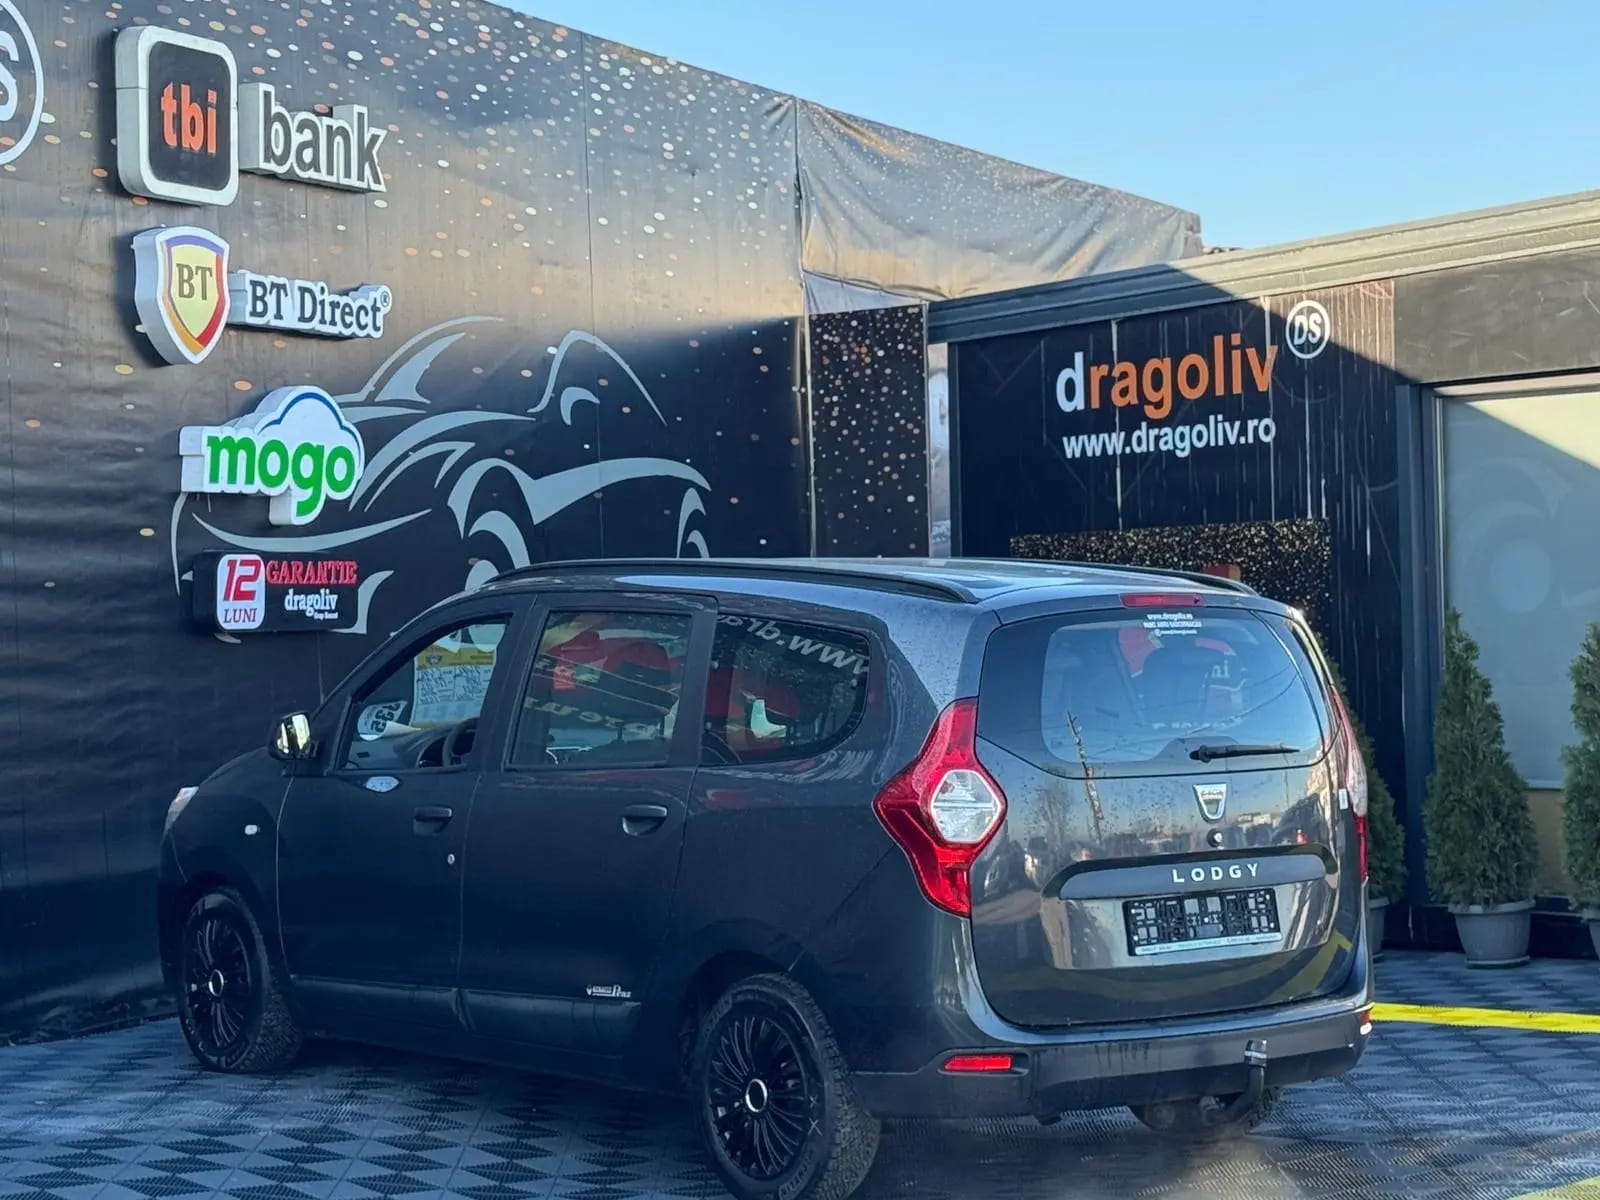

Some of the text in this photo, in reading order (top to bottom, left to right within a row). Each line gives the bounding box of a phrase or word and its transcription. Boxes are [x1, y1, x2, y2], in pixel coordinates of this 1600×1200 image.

[161, 81, 384, 187] tbi bank
[176, 263, 213, 300] BT
[249, 279, 289, 321] BT
[1293, 310, 1323, 346] DS
[1056, 332, 1279, 420] dragoliv
[1062, 413, 1277, 459] www.dragoliv.ro
[207, 435, 356, 517] mogo
[223, 558, 262, 602] 12
[265, 559, 358, 585] GARANTIE
[223, 608, 258, 624] LUNI
[284, 588, 339, 617] dragoliv
[1172, 863, 1259, 883] LODGY
